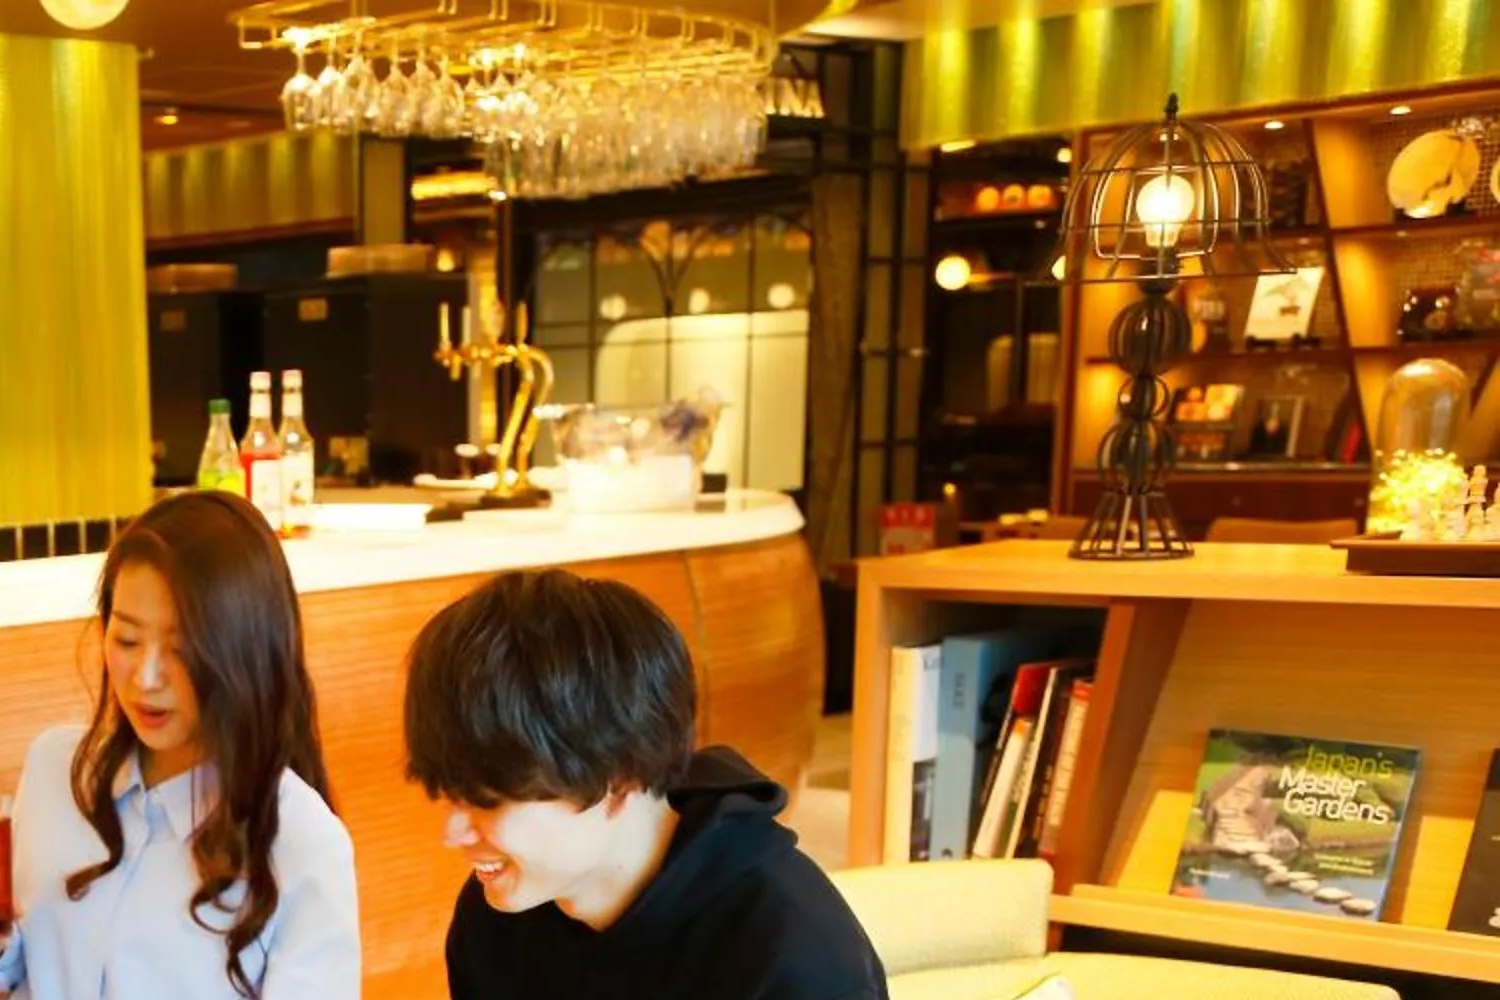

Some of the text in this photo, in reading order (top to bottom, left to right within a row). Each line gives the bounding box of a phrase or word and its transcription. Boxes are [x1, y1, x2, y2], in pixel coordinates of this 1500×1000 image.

[1304, 745, 1394, 779] Japan's
[1278, 764, 1367, 800] Master
[1282, 788, 1389, 825] Gardens
